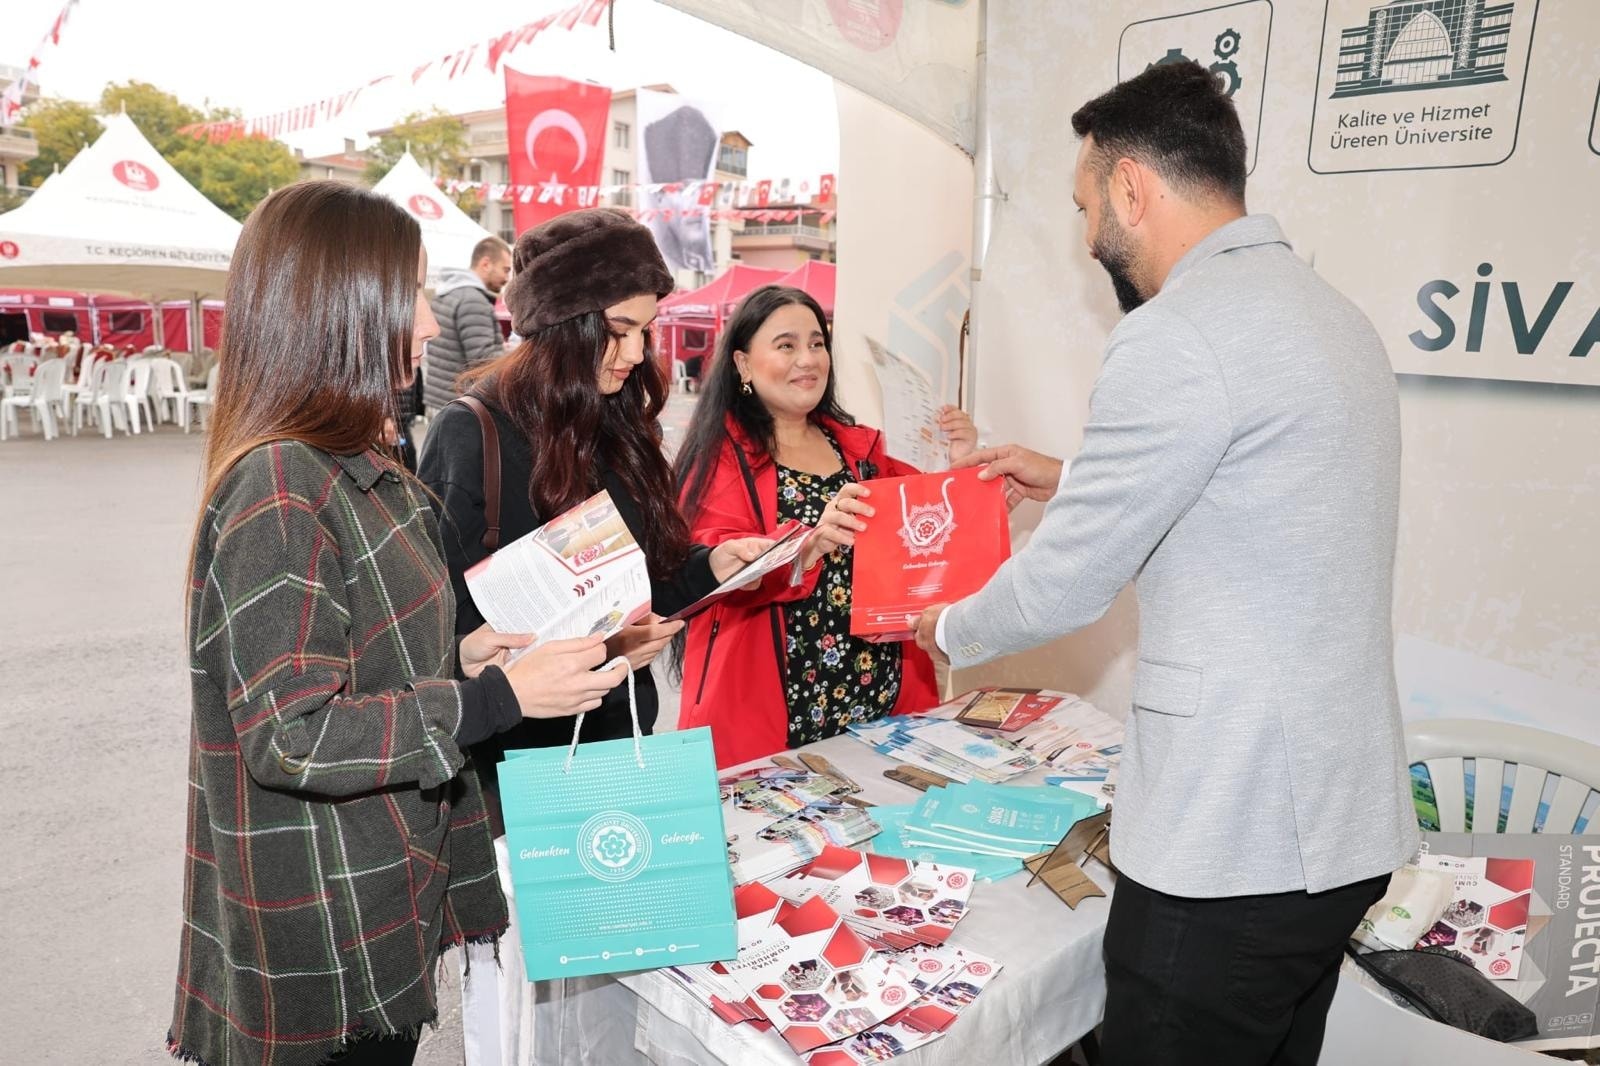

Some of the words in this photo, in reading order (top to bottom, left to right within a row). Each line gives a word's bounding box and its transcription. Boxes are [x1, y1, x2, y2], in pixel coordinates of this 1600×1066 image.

[1338, 109, 1387, 129] Kalite
[1393, 112, 1415, 124] ve
[1421, 103, 1491, 122] Hizmet
[1330, 131, 1388, 150] Üreten
[1395, 126, 1493, 145] Üniversite
[519, 845, 570, 860] Gelenekten
[1556, 844, 1573, 910] STANDARD
